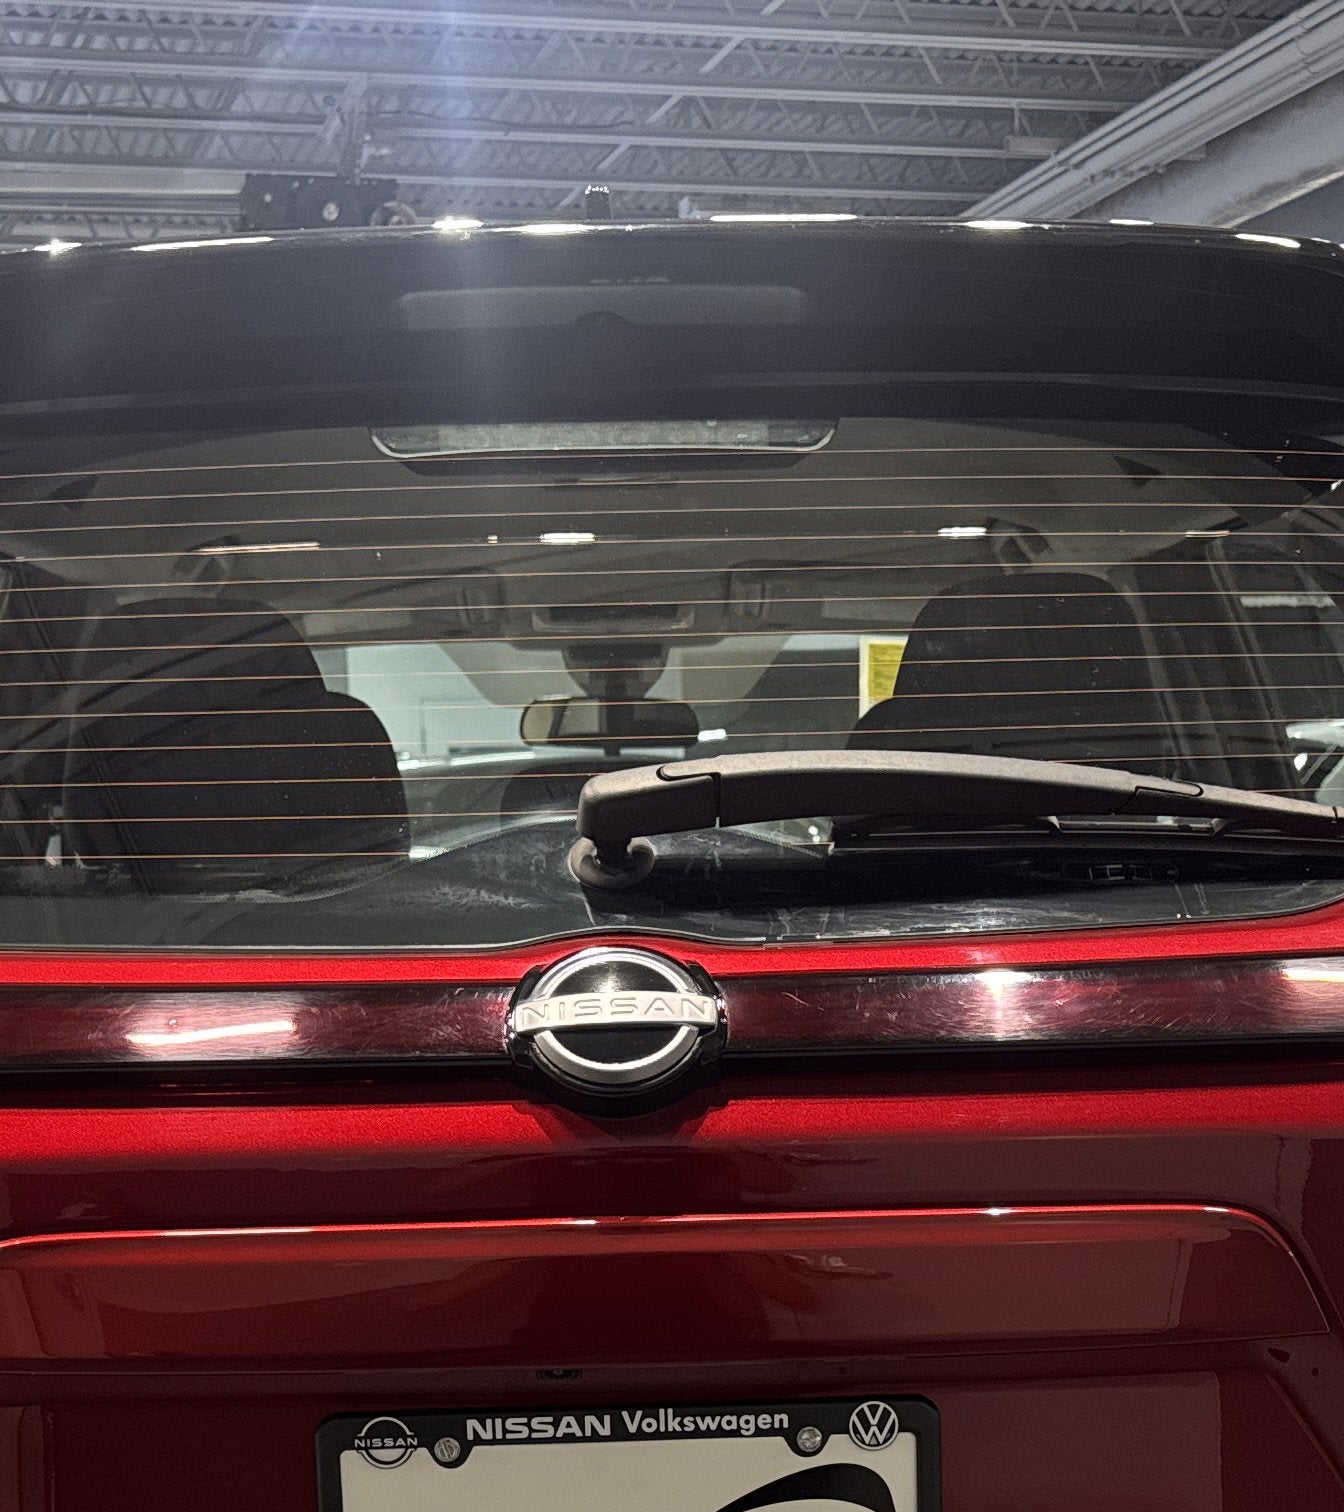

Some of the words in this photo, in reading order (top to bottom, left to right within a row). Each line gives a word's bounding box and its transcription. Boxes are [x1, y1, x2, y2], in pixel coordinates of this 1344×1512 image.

[521, 996, 709, 1021] NISSAN
[466, 1412, 612, 1441] NISSAN
[621, 1410, 790, 1437] Volkswagen
[354, 1437, 418, 1449] NISSAN
